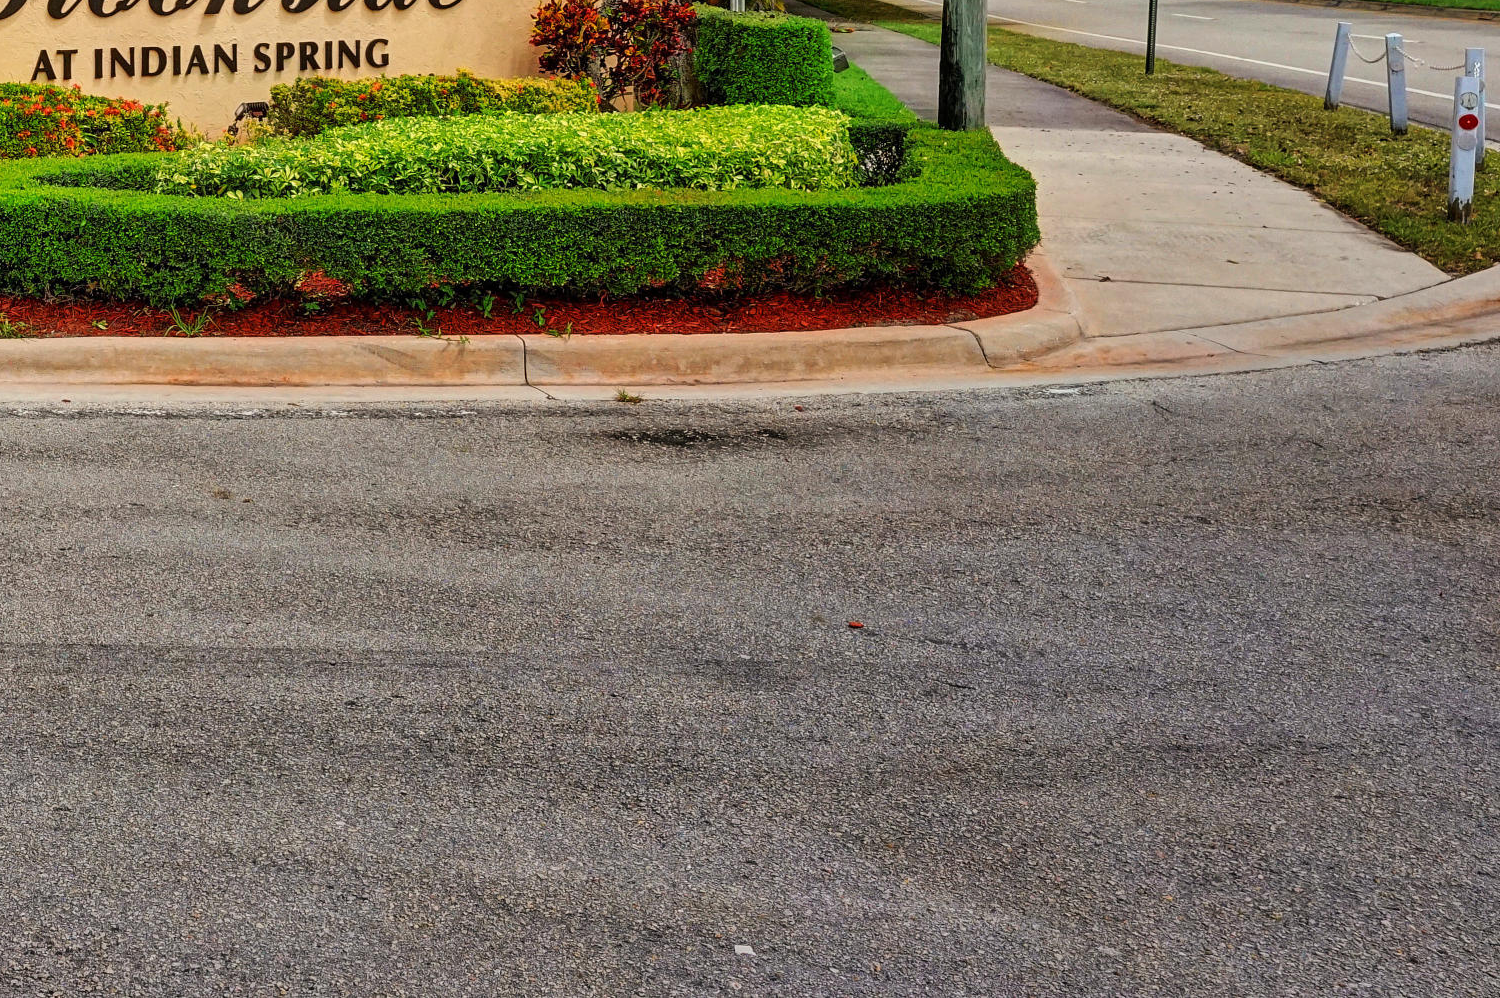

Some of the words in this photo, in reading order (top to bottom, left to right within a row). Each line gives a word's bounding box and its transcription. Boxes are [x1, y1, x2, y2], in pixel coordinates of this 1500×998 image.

[31, 49, 79, 81] AT
[94, 43, 238, 79] INDIAN
[254, 38, 390, 73] SPRING
